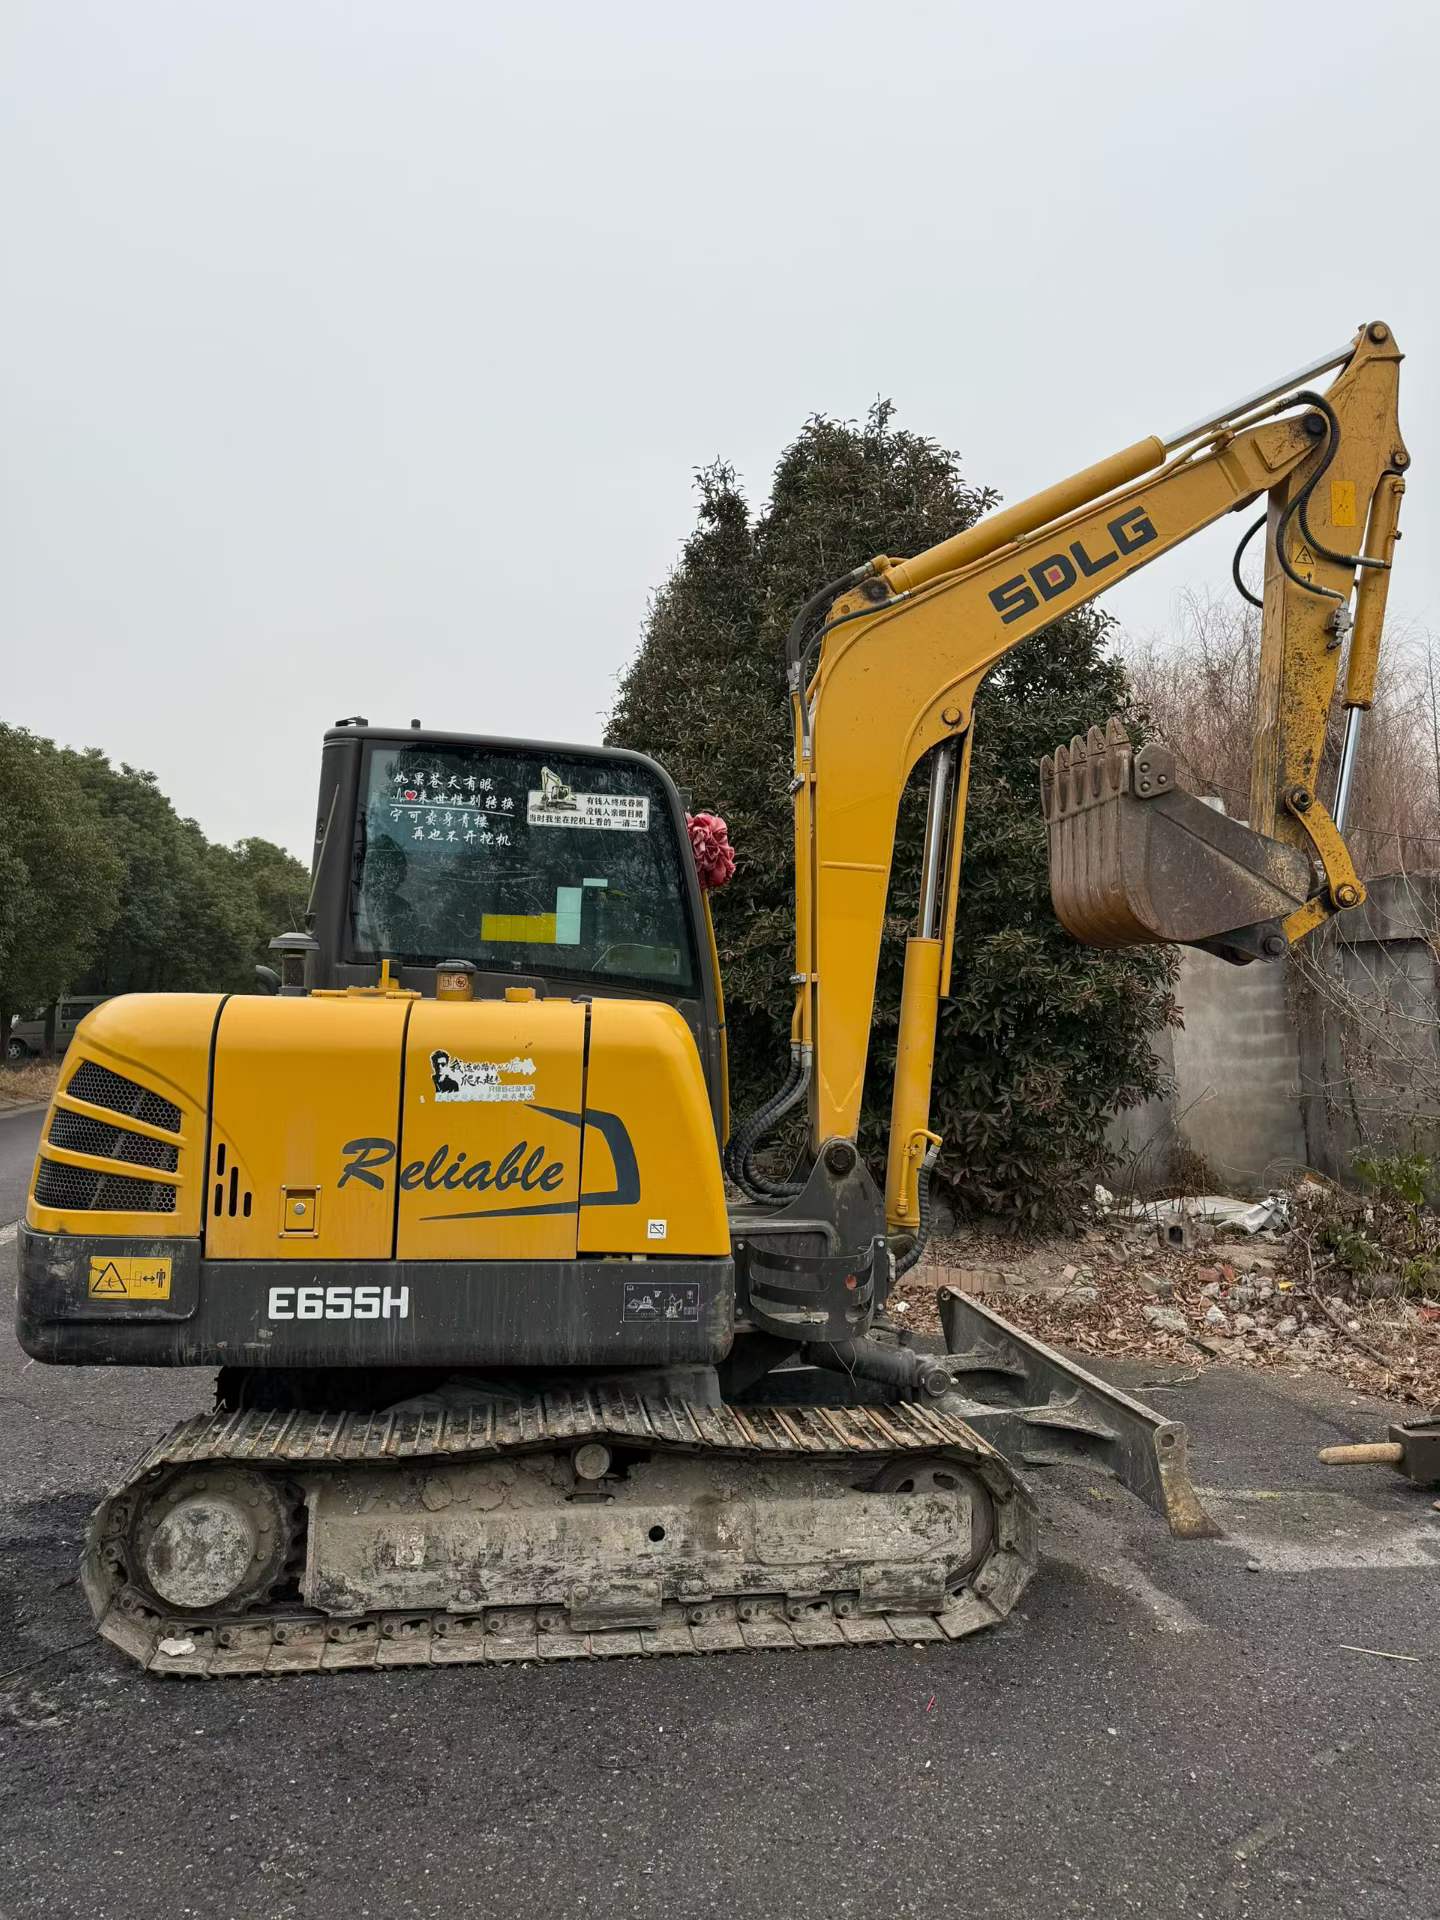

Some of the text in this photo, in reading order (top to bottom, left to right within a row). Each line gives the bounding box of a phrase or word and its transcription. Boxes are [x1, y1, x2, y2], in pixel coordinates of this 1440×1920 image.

[988, 505, 1158, 624] SDLG
[394, 771, 494, 791] 如果苍天有眼
[418, 791, 514, 809] 来世性别转换
[390, 808, 489, 828] 宁可卖身青楼
[411, 826, 512, 846] 再也不开挖机
[337, 1138, 564, 1191] Reliable
[268, 1286, 409, 1319] E655H
